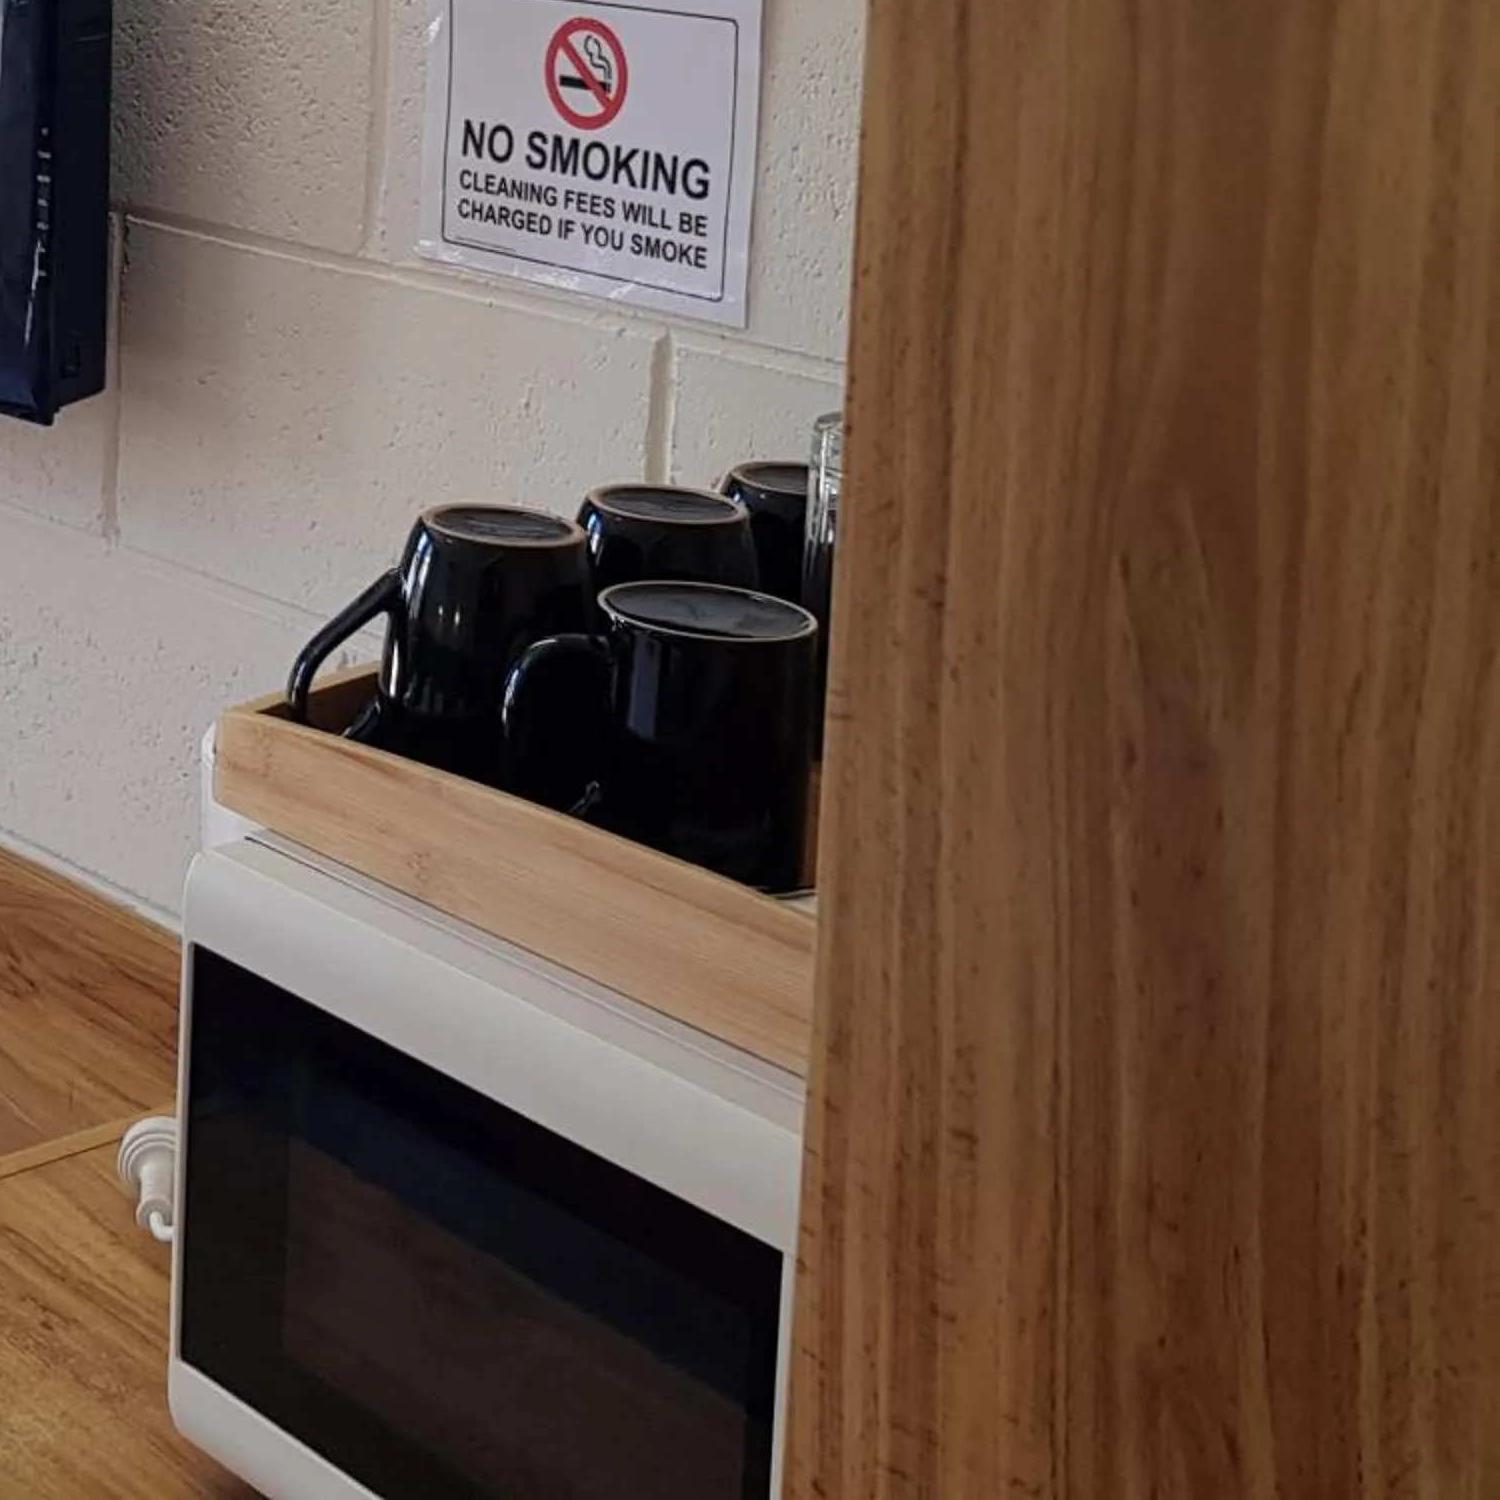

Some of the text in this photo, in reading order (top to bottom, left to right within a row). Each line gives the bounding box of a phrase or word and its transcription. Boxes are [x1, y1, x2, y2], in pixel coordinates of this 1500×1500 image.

[461, 119, 710, 201] NO SMOKING
[457, 198, 708, 269] CHARGED IF YOU SMOKE
[459, 169, 708, 237] CLEANING FEES WILL BE
